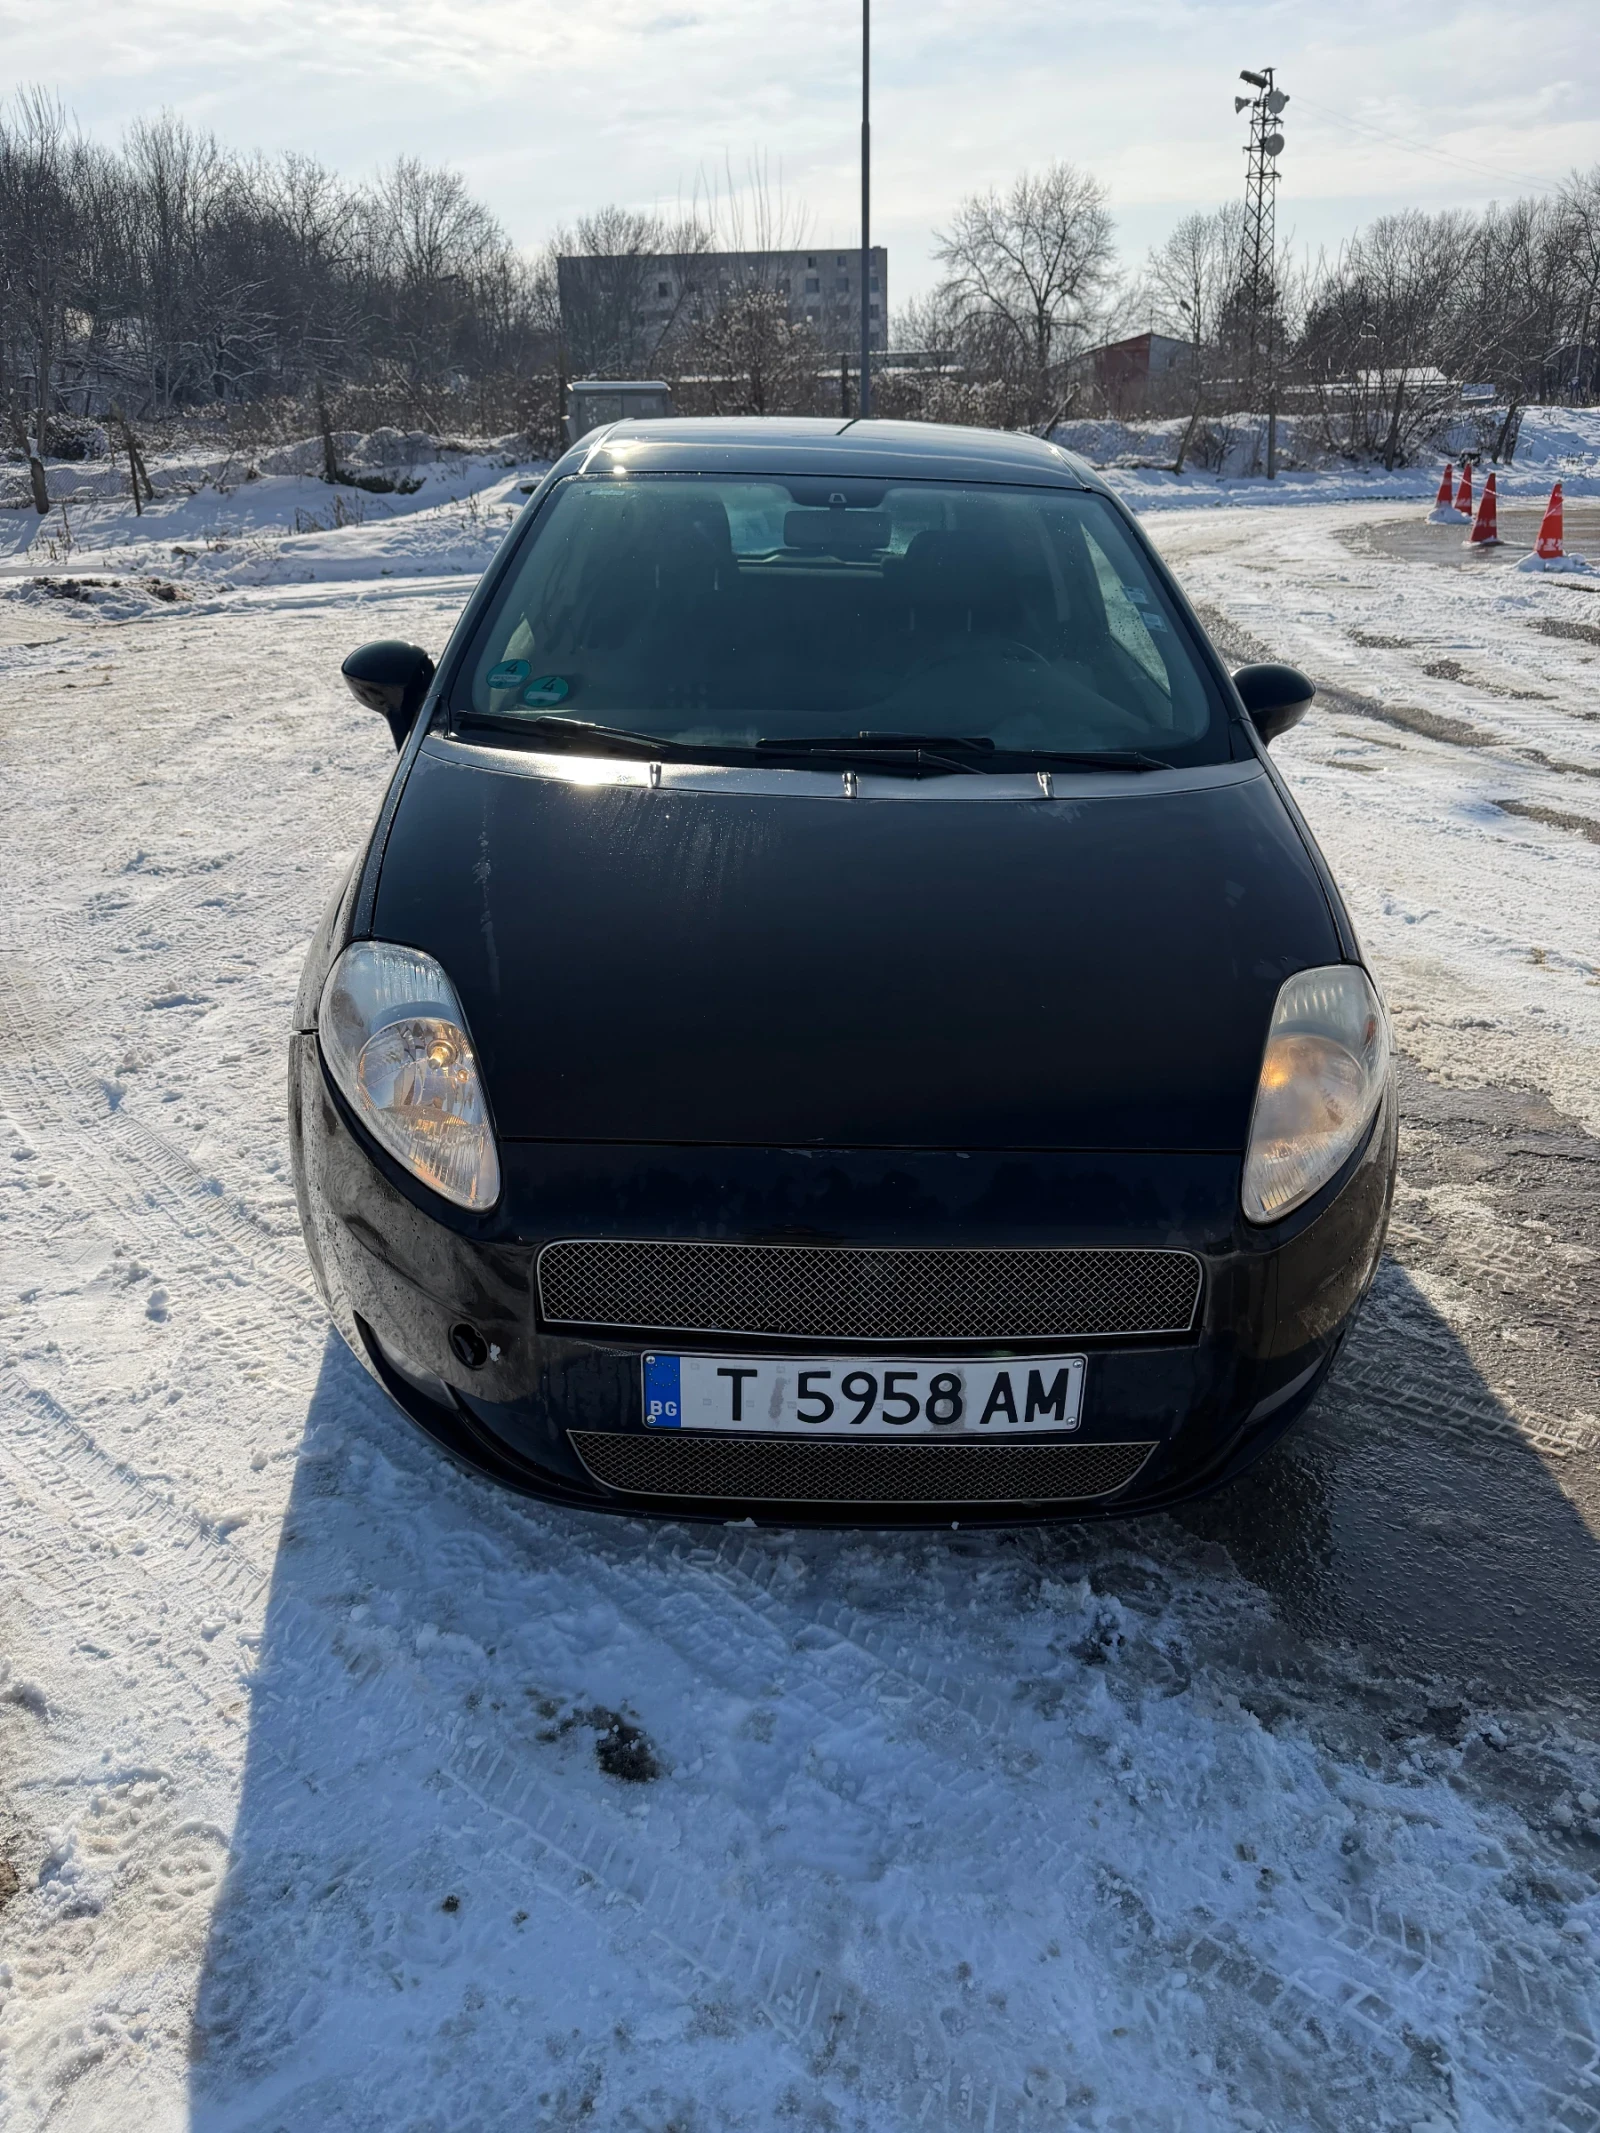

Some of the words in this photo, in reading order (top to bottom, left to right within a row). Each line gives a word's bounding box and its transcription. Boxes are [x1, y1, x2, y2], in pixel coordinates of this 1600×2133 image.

[505, 661, 518, 674] 4
[542, 678, 556, 692] 4
[717, 1368, 758, 1422] T
[797, 1370, 963, 1426] 5958
[979, 1368, 1070, 1425] AM
[650, 1400, 678, 1417] BG
